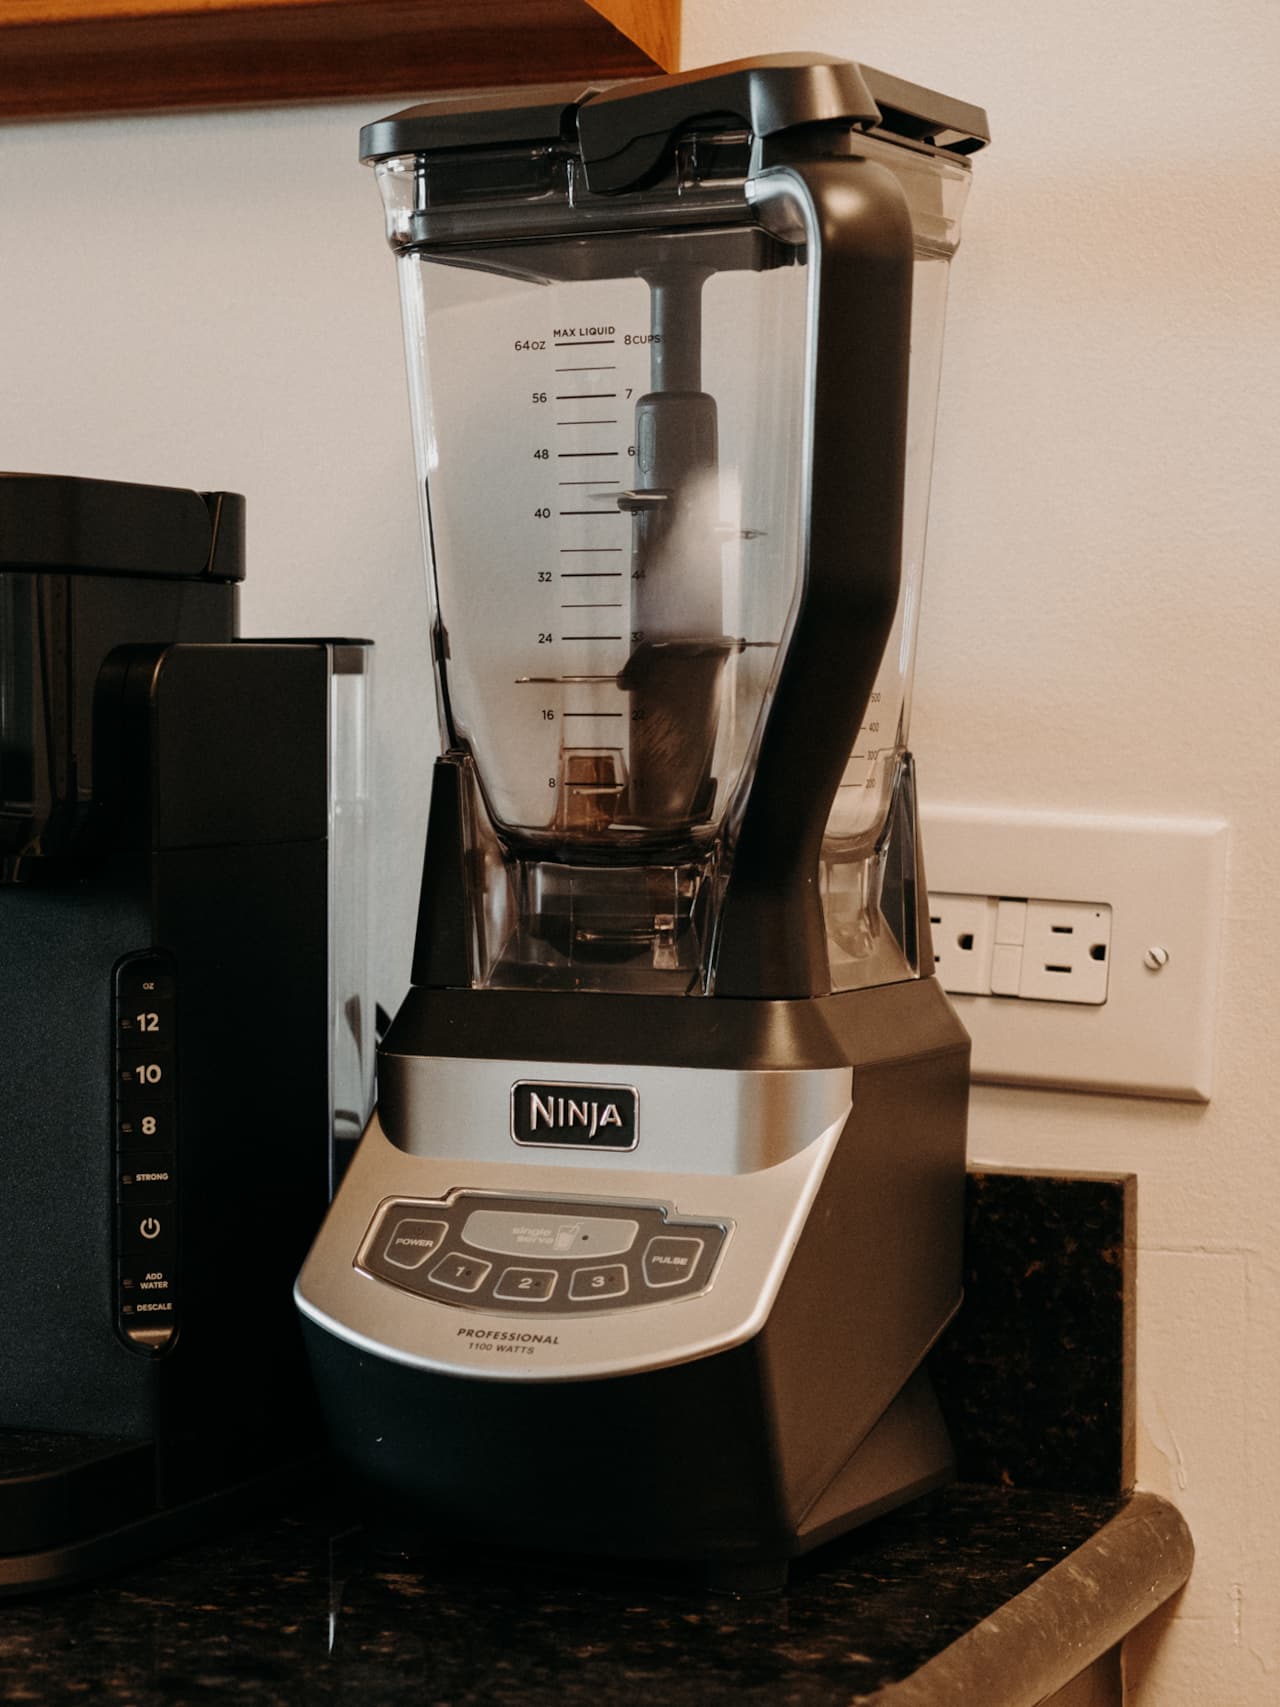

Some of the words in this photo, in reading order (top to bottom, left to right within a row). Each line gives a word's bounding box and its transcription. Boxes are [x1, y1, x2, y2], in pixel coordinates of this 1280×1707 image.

[553, 328, 576, 337] MAX
[579, 326, 615, 336] LIQUID
[532, 393, 547, 403] 56
[626, 388, 632, 399] 7
[533, 449, 549, 460] 48
[627, 446, 635, 456] 6
[534, 508, 550, 518] 40
[538, 572, 552, 582] 32
[538, 633, 553, 643] 24
[542, 710, 554, 720] 16
[869, 722, 879, 732] 400
[548, 778, 556, 788] 8
[137, 1013, 159, 1032] 12
[136, 1064, 162, 1084] 10
[530, 1092, 622, 1138] NINJA
[141, 1116, 156, 1135] 8
[136, 1173, 168, 1182] STRONG
[395, 1238, 434, 1247] POWER
[652, 1255, 688, 1265] PULSE
[456, 1266, 466, 1277] 1
[145, 1273, 163, 1281] ADD
[592, 1276, 605, 1287] 3
[140, 1281, 168, 1290] WATER
[518, 1277, 531, 1289] 2
[137, 1303, 172, 1312] DESCALE
[456, 1328, 559, 1345] PROFESSIONAL
[468, 1342, 493, 1351] 1100
[496, 1344, 535, 1355] WATTS
